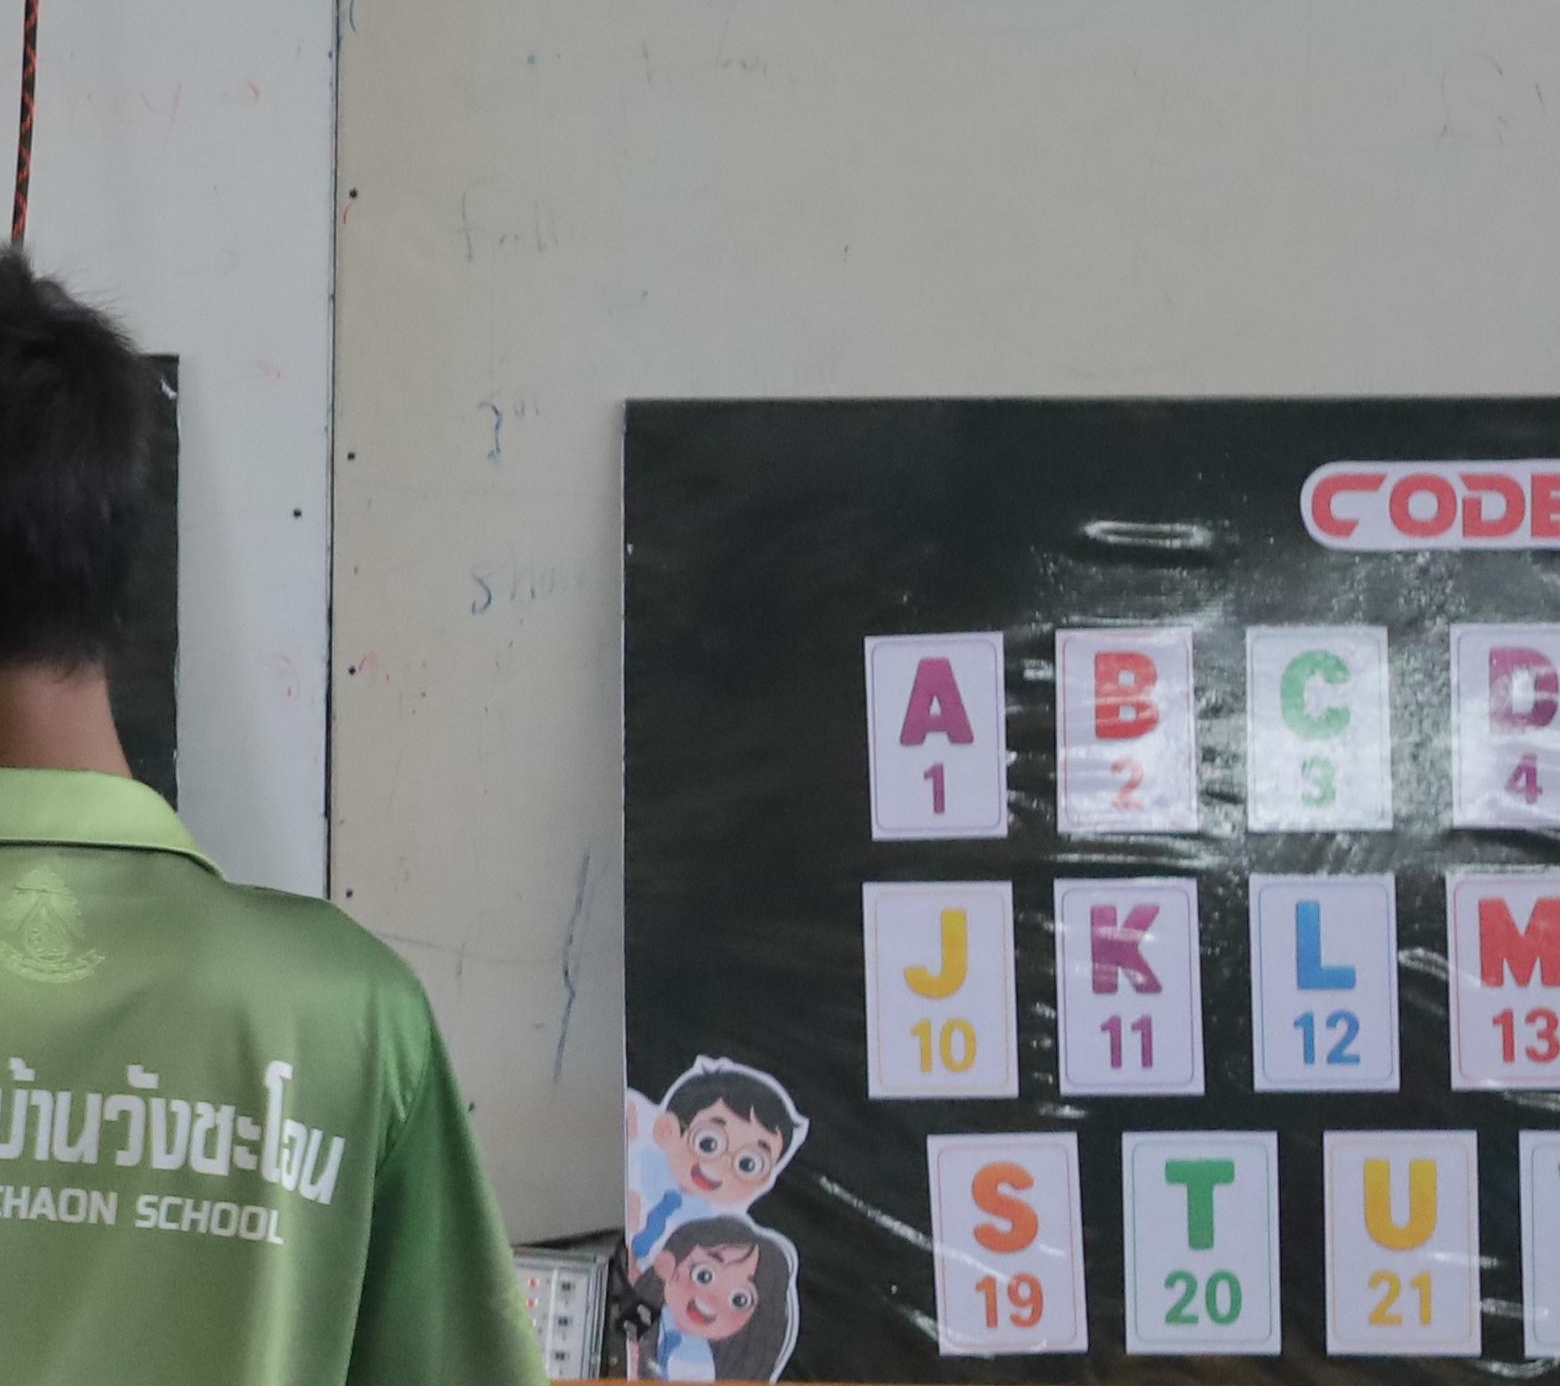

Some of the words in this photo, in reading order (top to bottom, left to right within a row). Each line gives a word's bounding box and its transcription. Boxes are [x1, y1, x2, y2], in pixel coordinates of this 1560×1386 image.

[899, 657, 975, 747] A
[1093, 651, 1160, 741] B
[1281, 649, 1350, 739] C
[1489, 646, 1559, 735] D
[923, 763, 946, 814] 1
[1110, 759, 1145, 814] 2
[1301, 757, 1336, 808] 3
[1505, 754, 1543, 805] 4
[903, 907, 968, 999] J
[1089, 903, 1163, 996] K
[1295, 899, 1356, 991] L
[1478, 898, 1560, 988] M
[909, 1018, 977, 1074] 10
[1100, 1016, 1155, 1070] 11
[1292, 1010, 1361, 1066] 12
[1492, 1007, 1560, 1065] 13
[135, 1194, 284, 1245] SCHOOL
[970, 1162, 1040, 1255] S
[1165, 1159, 1236, 1251] T
[1362, 1158, 1438, 1251] U
[974, 1274, 1045, 1330] 19
[1163, 1270, 1243, 1327] 20
[1366, 1270, 1434, 1327] 21
